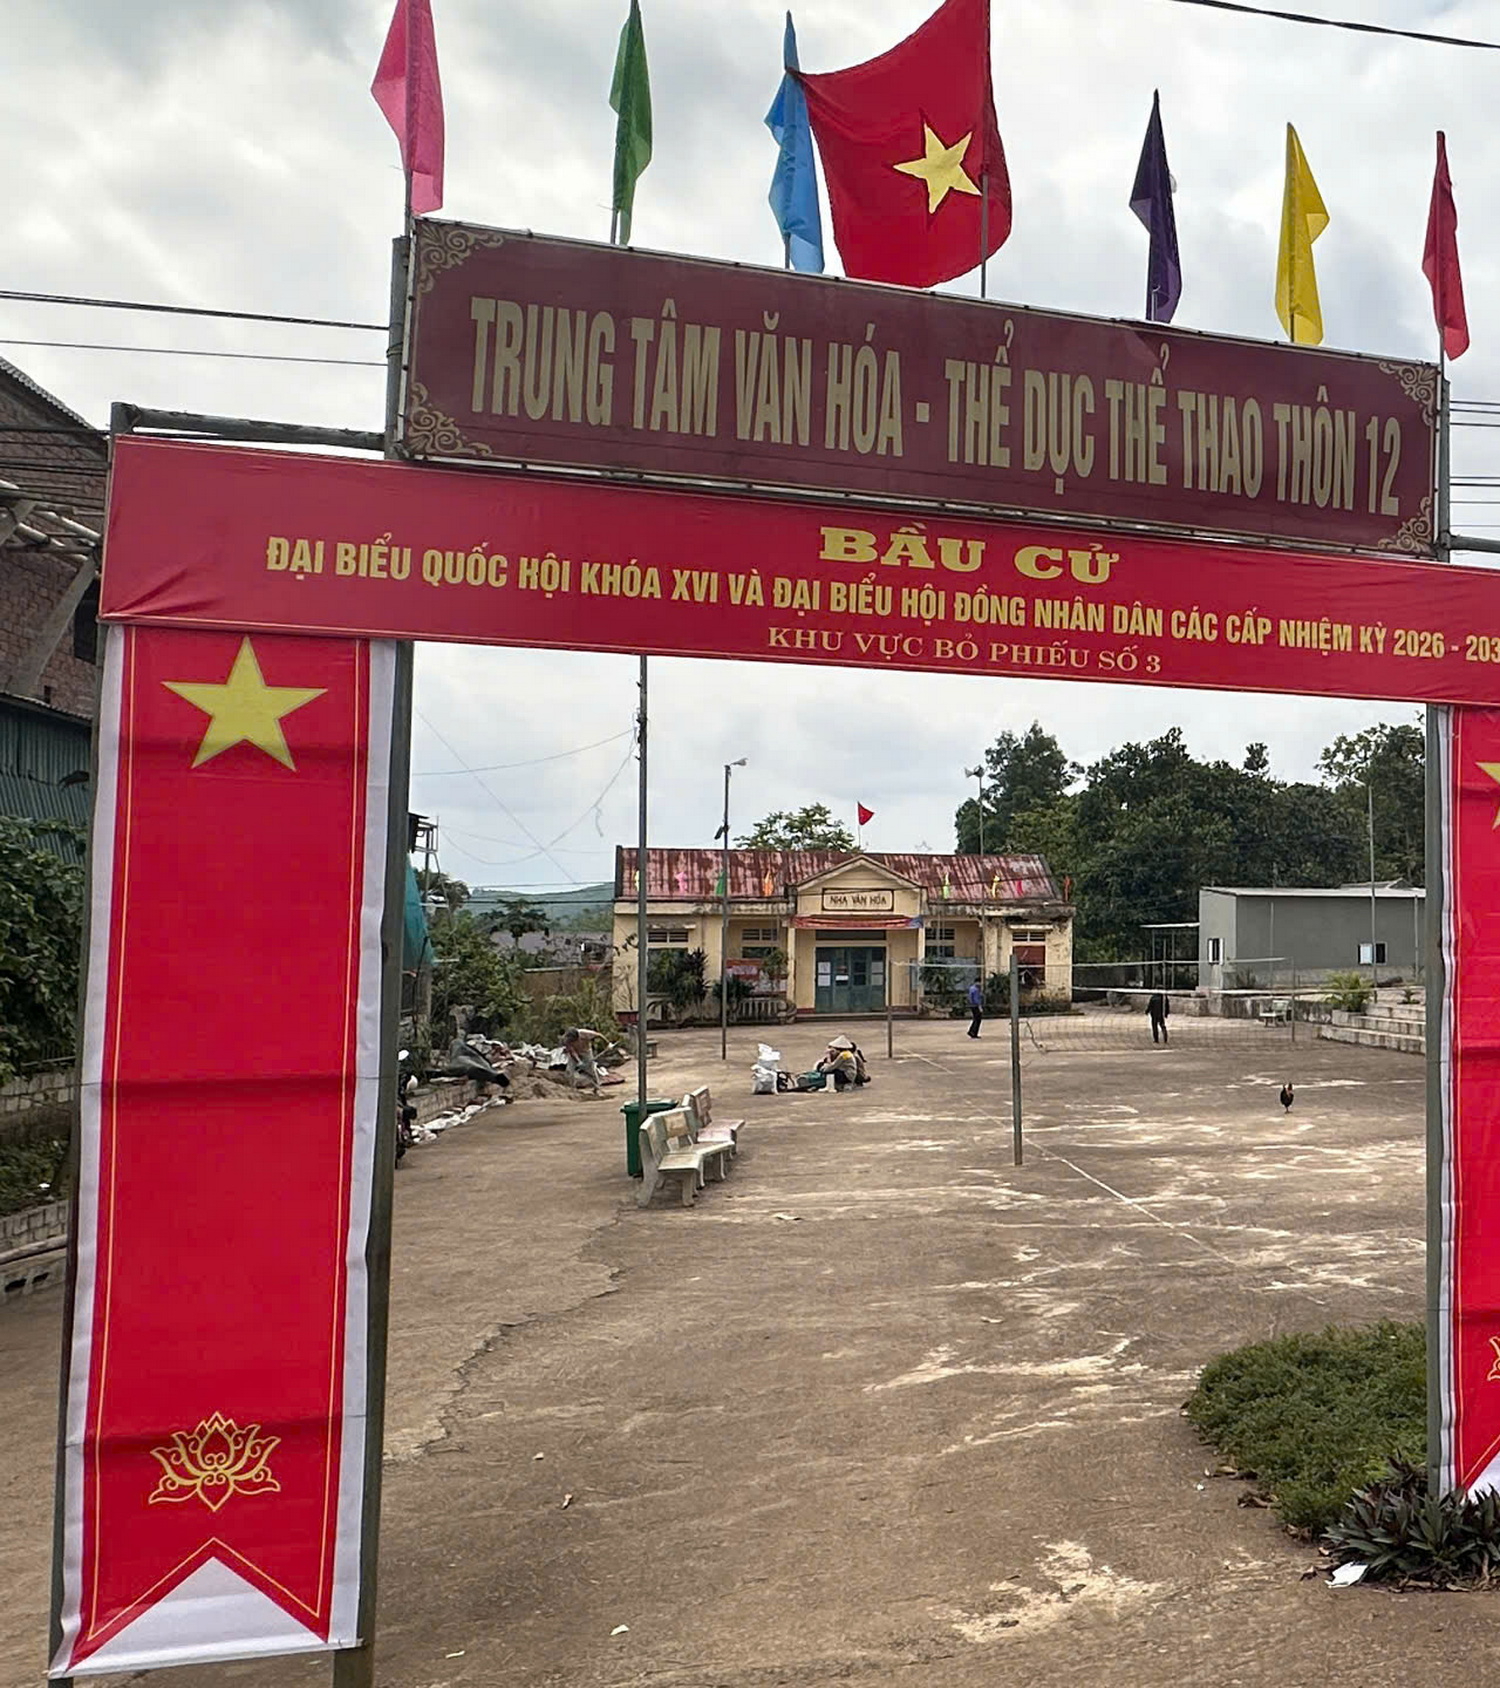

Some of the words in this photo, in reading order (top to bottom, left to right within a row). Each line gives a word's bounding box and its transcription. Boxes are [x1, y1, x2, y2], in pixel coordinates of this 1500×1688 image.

[470, 296, 616, 426] TRUNG
[631, 298, 722, 437] TÂM
[735, 310, 812, 447] VĂN
[824, 323, 904, 457] HÓA
[915, 402, 930, 423] -
[945, 319, 1014, 468] THỂ
[1023, 369, 1095, 495] DỤC
[1105, 343, 1170, 485] THỂ
[1178, 390, 1264, 499] THAO
[1273, 385, 1357, 511] THÔN
[1366, 416, 1401, 516] 12
[266, 536, 325, 581] ĐẠI
[335, 532, 412, 580] BIỂU
[422, 541, 508, 588] QUỐC
[518, 552, 571, 598] HỘI
[581, 558, 662, 600] KHÓA
[670, 568, 719, 603] XVI
[728, 567, 765, 607] VÀ
[773, 575, 820, 617] ĐẠI
[830, 572, 893, 617] BIỂU
[901, 583, 946, 625] HỘI
[954, 583, 1025, 626] ĐỒNG
[1034, 596, 1105, 633] NHÂN
[1113, 601, 1163, 637] DÂN
[1171, 605, 1219, 642] CÁC
[1226, 606, 1272, 645] CẤP
[1279, 617, 1353, 656] NHIỆM
[1359, 620, 1387, 655] KỲ
[1393, 628, 1445, 659] 2026
[818, 521, 986, 572] BẦU
[1013, 543, 1120, 584] CỬ
[767, 626, 844, 651] KHU
[853, 633, 924, 660] VỰC
[933, 633, 979, 662] BỎ
[988, 640, 1091, 669] PHIẾU
[1098, 644, 1139, 672] SỐ
[1145, 655, 1162, 674] 3
